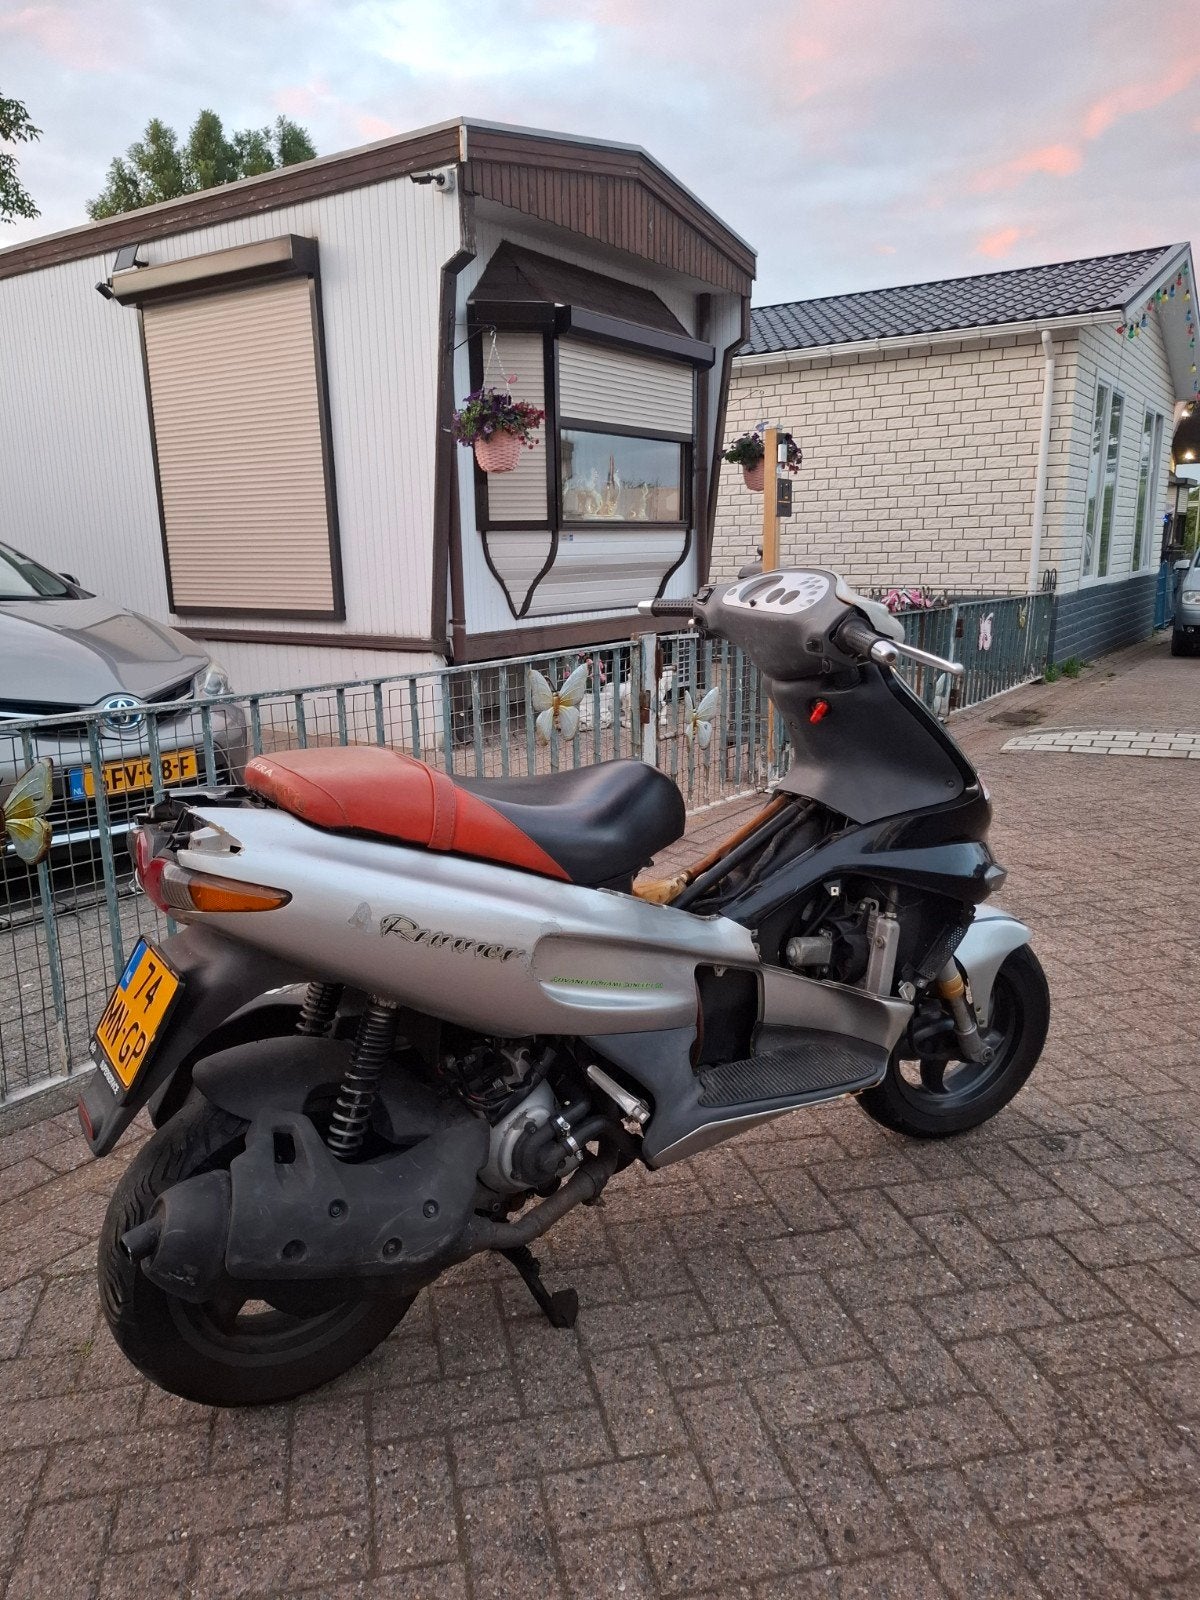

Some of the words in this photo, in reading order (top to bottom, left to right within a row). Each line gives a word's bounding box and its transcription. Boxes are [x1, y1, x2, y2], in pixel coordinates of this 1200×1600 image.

[73, 787, 84, 796] NL
[100, 756, 189, 791] FV-8-F
[380, 914, 526, 962] Runner
[133, 961, 163, 1014] 74
